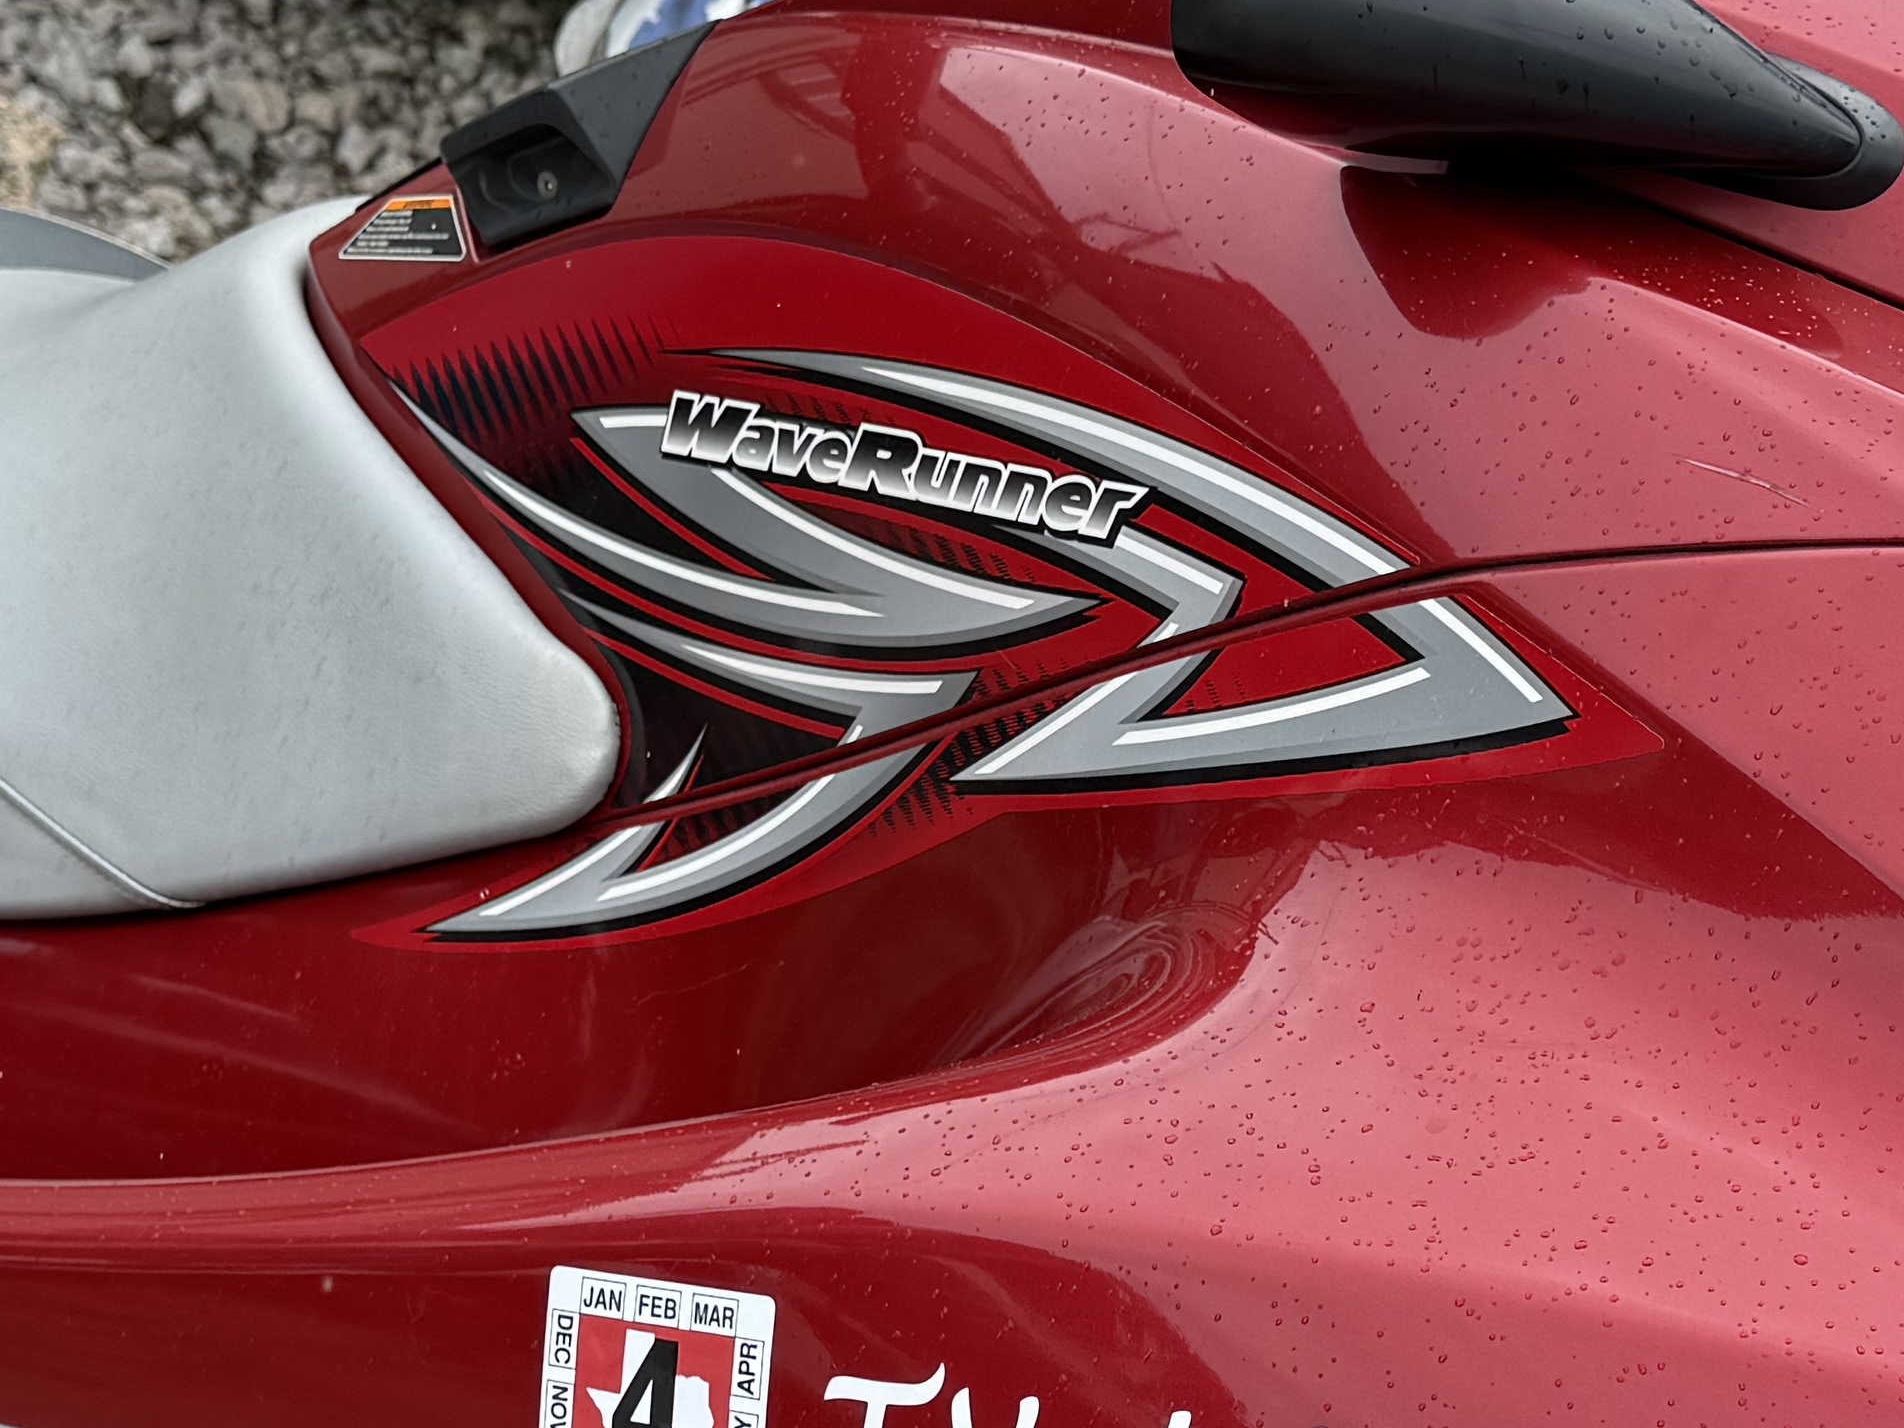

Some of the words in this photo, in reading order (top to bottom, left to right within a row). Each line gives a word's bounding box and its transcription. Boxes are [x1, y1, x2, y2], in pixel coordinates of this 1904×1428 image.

[661, 390, 1151, 539] WaveRunner
[583, 1287, 623, 1313] JAN
[638, 1295, 677, 1321] FEB
[694, 1302, 735, 1330] MAR
[554, 1314, 574, 1366] DEC
[737, 1342, 758, 1396] APR
